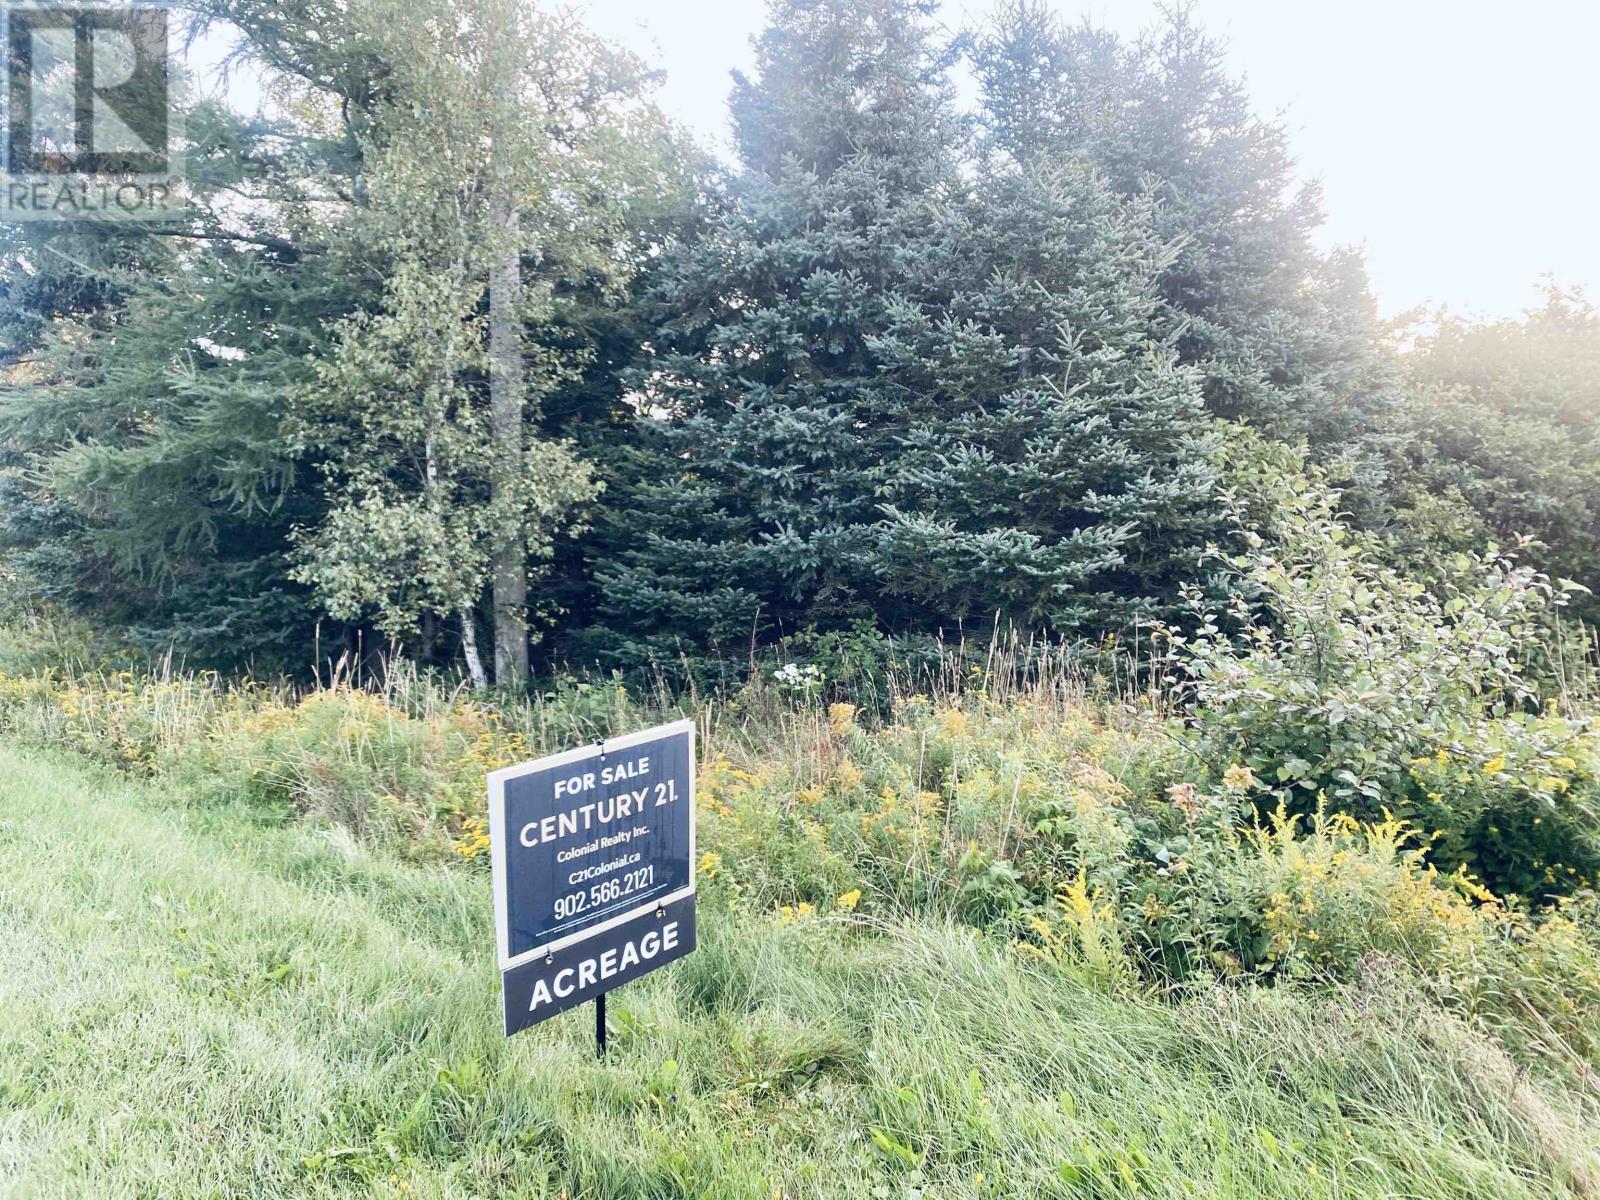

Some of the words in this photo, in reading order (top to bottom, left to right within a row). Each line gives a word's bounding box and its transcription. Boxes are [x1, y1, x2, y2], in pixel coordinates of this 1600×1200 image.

[554, 773, 595, 799] FOR
[601, 757, 650, 785] SALE
[519, 787, 649, 848] CENTURY
[556, 842, 599, 863] Colonial
[600, 831, 631, 849] Realty
[633, 824, 650, 838] Inc.
[553, 865, 654, 920] 902.566.2121
[568, 852, 641, 885] C21Colonial.ca
[528, 921, 679, 1012] ACREAGE
